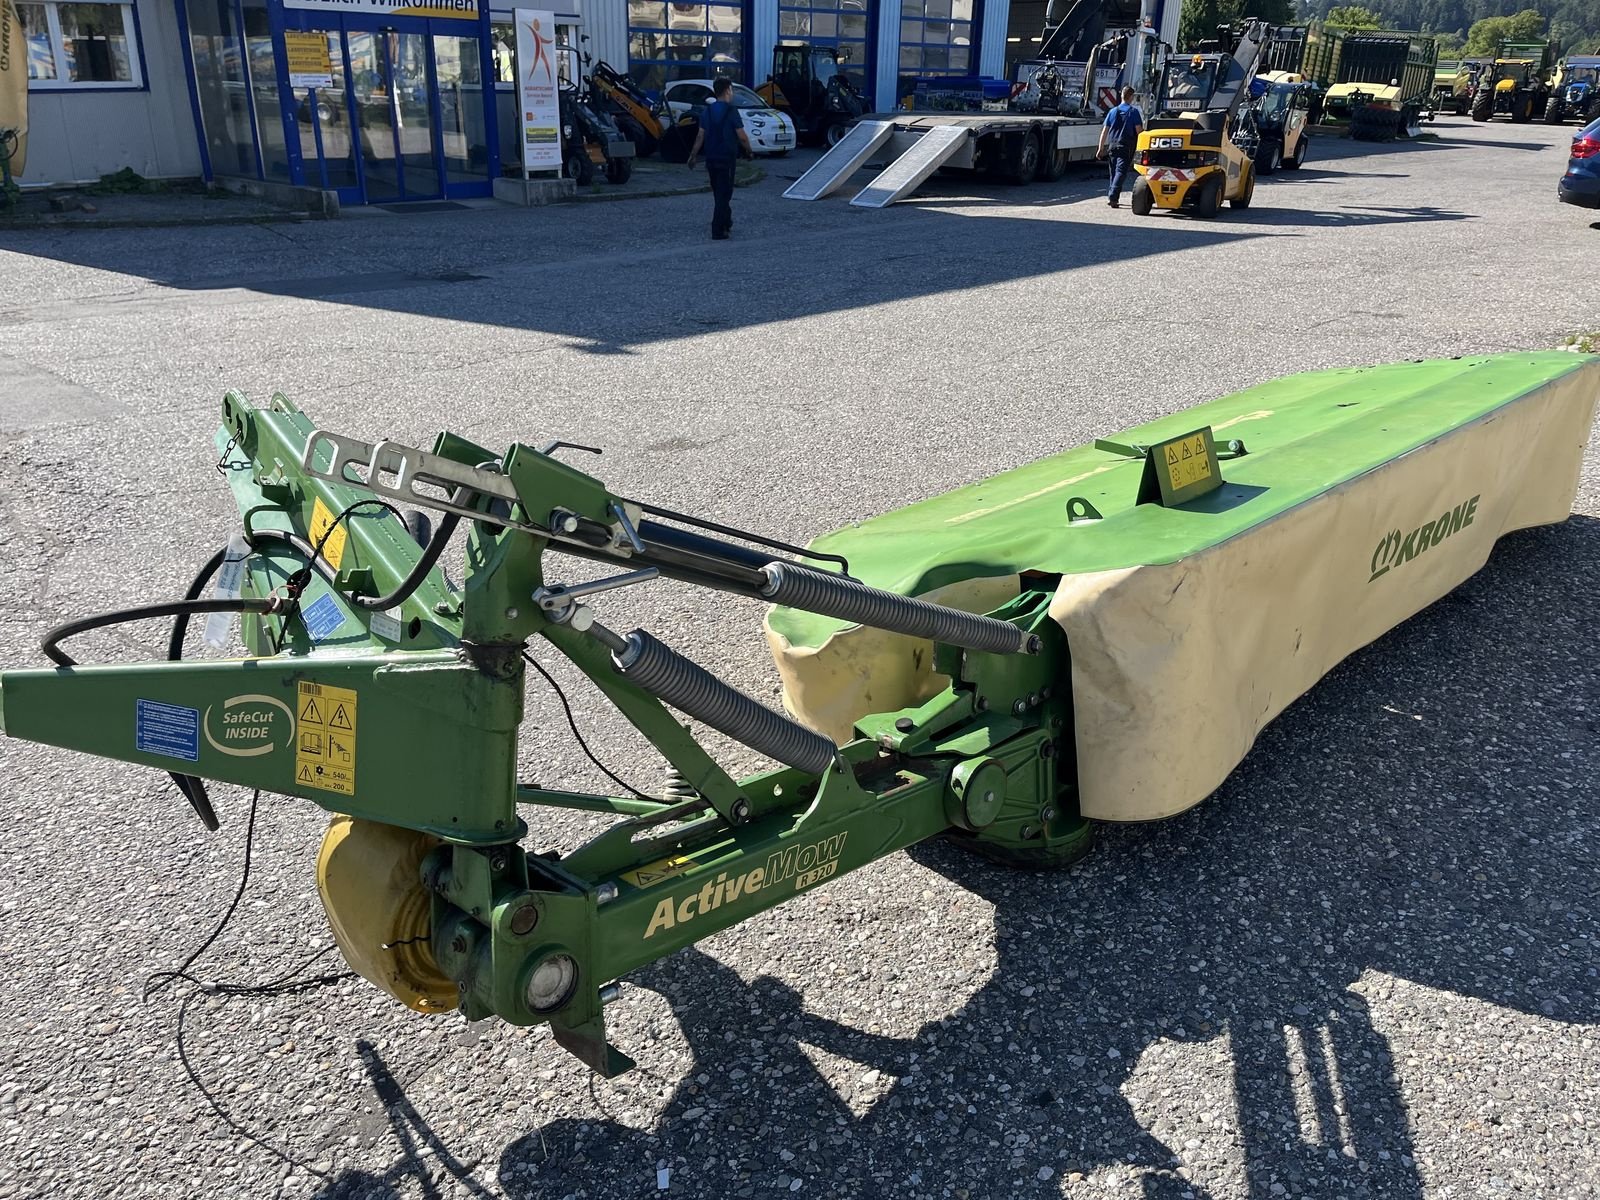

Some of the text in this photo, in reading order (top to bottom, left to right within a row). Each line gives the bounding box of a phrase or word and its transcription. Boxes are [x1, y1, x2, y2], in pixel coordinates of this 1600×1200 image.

[1150, 137, 1183, 148] JCB
[1393, 494, 1480, 568] KRONE
[222, 711, 274, 724] SafeCut
[225, 727, 269, 739] INSIDE
[332, 782, 345, 791] 200
[800, 864, 833, 887] R 320
[643, 831, 848, 940] ActiveMow
